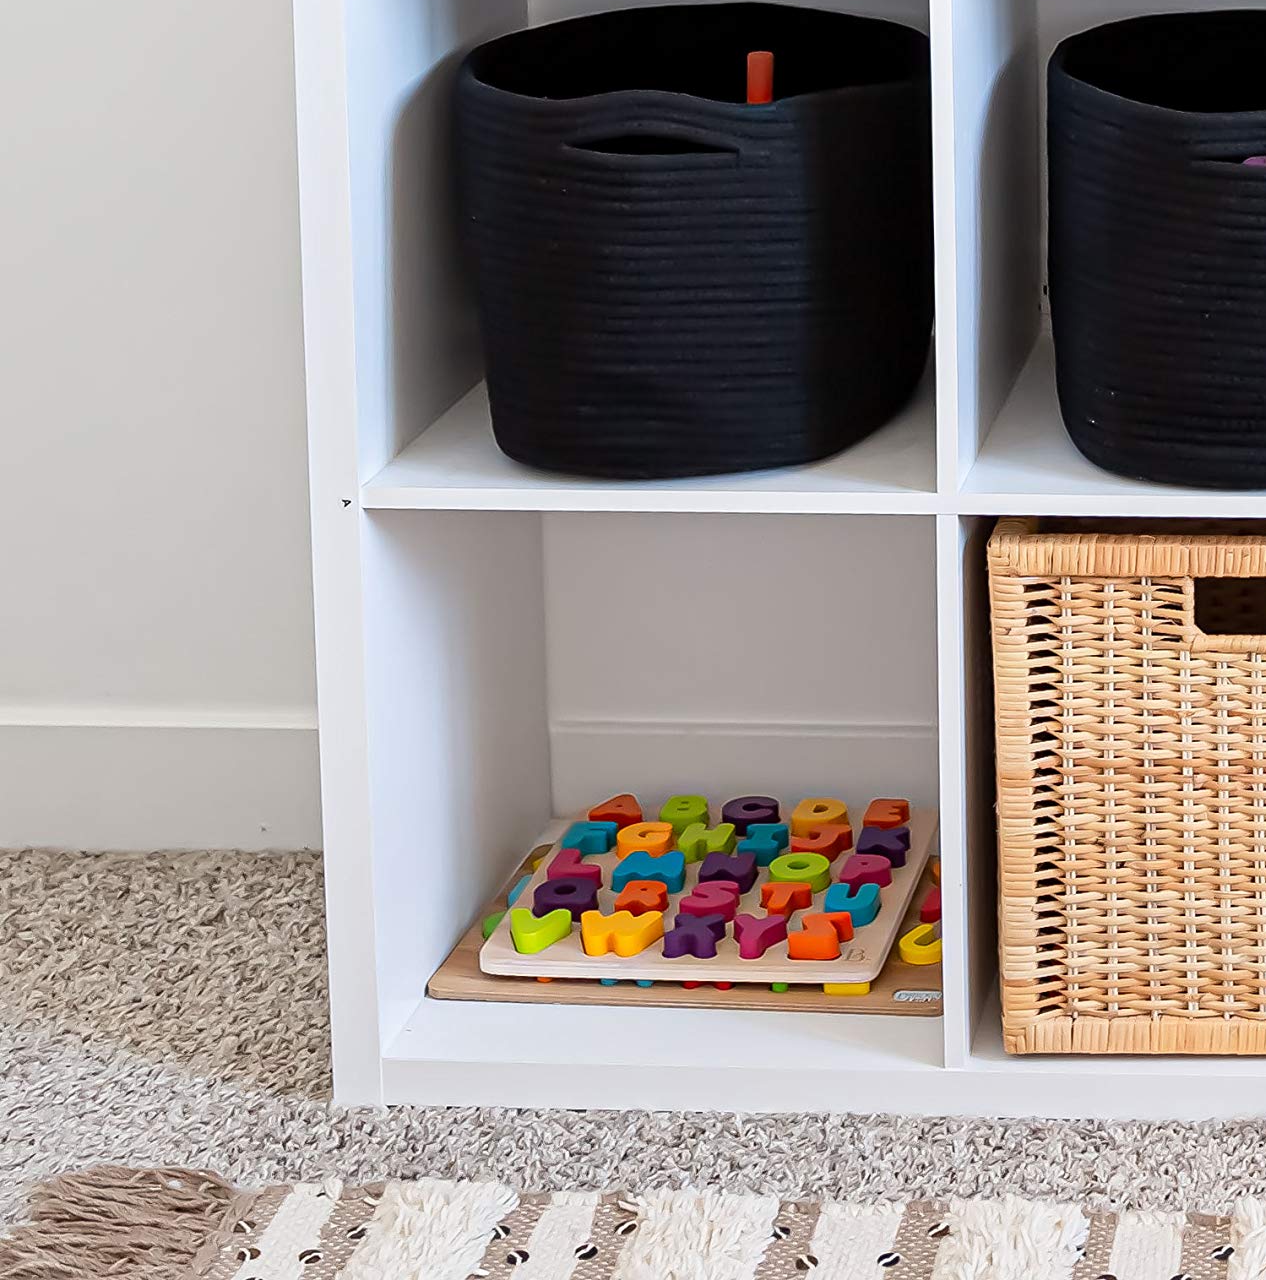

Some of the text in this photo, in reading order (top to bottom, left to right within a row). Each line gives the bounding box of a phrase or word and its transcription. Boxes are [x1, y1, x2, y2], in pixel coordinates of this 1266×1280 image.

[588, 793, 910, 836] A B C D E
[562, 822, 910, 867] F G H I J K
[547, 848, 892, 894] L M N O P
[615, 880, 669, 916] R
[679, 881, 739, 922] S
[759, 882, 812, 922] T
[825, 883, 881, 927] U
[510, 908, 854, 960] V W X Y Z
